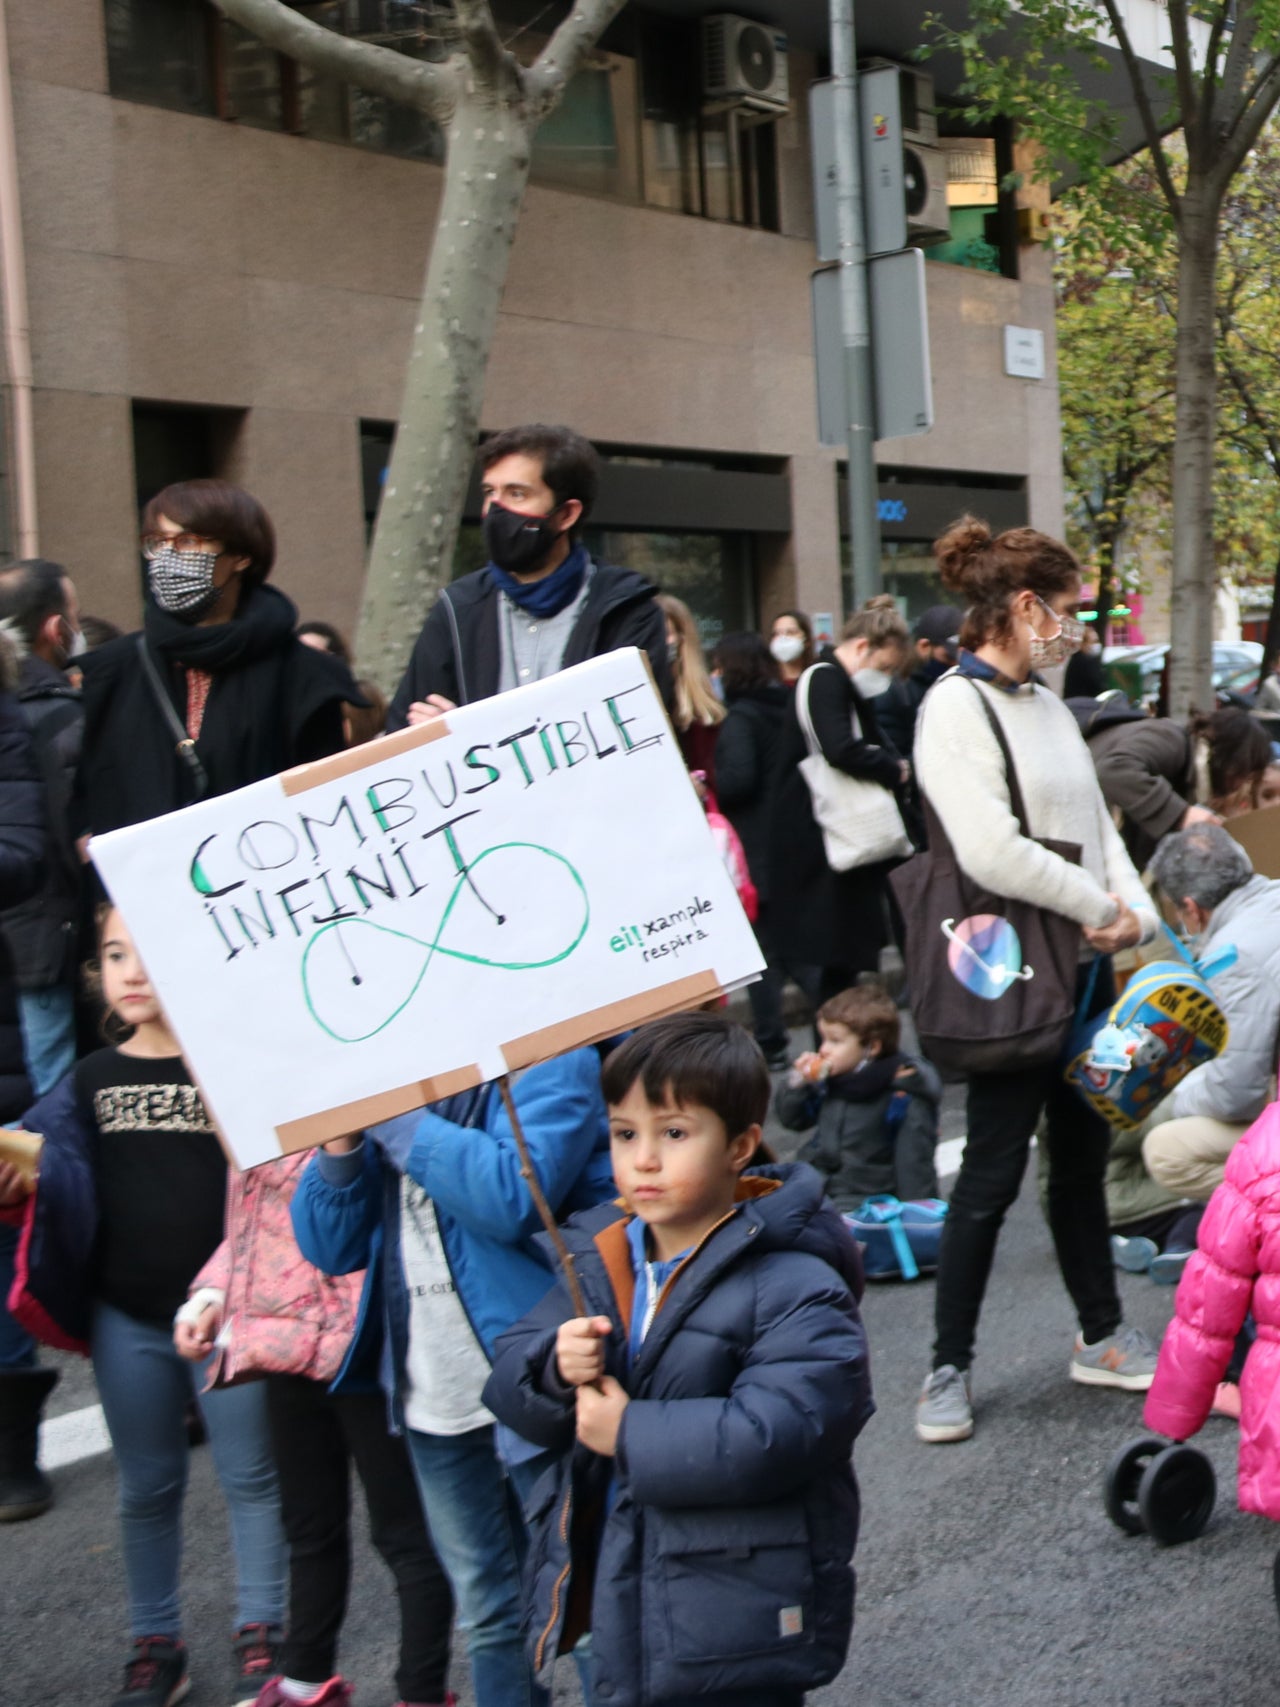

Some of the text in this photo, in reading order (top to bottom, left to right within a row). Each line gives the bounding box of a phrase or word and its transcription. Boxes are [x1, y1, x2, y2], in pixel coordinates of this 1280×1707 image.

[190, 683, 665, 898] COMBUSTIBLE
[202, 808, 483, 963] INFINIT
[642, 929, 711, 963] respira
[1160, 991, 1227, 1048] ON PATROL
